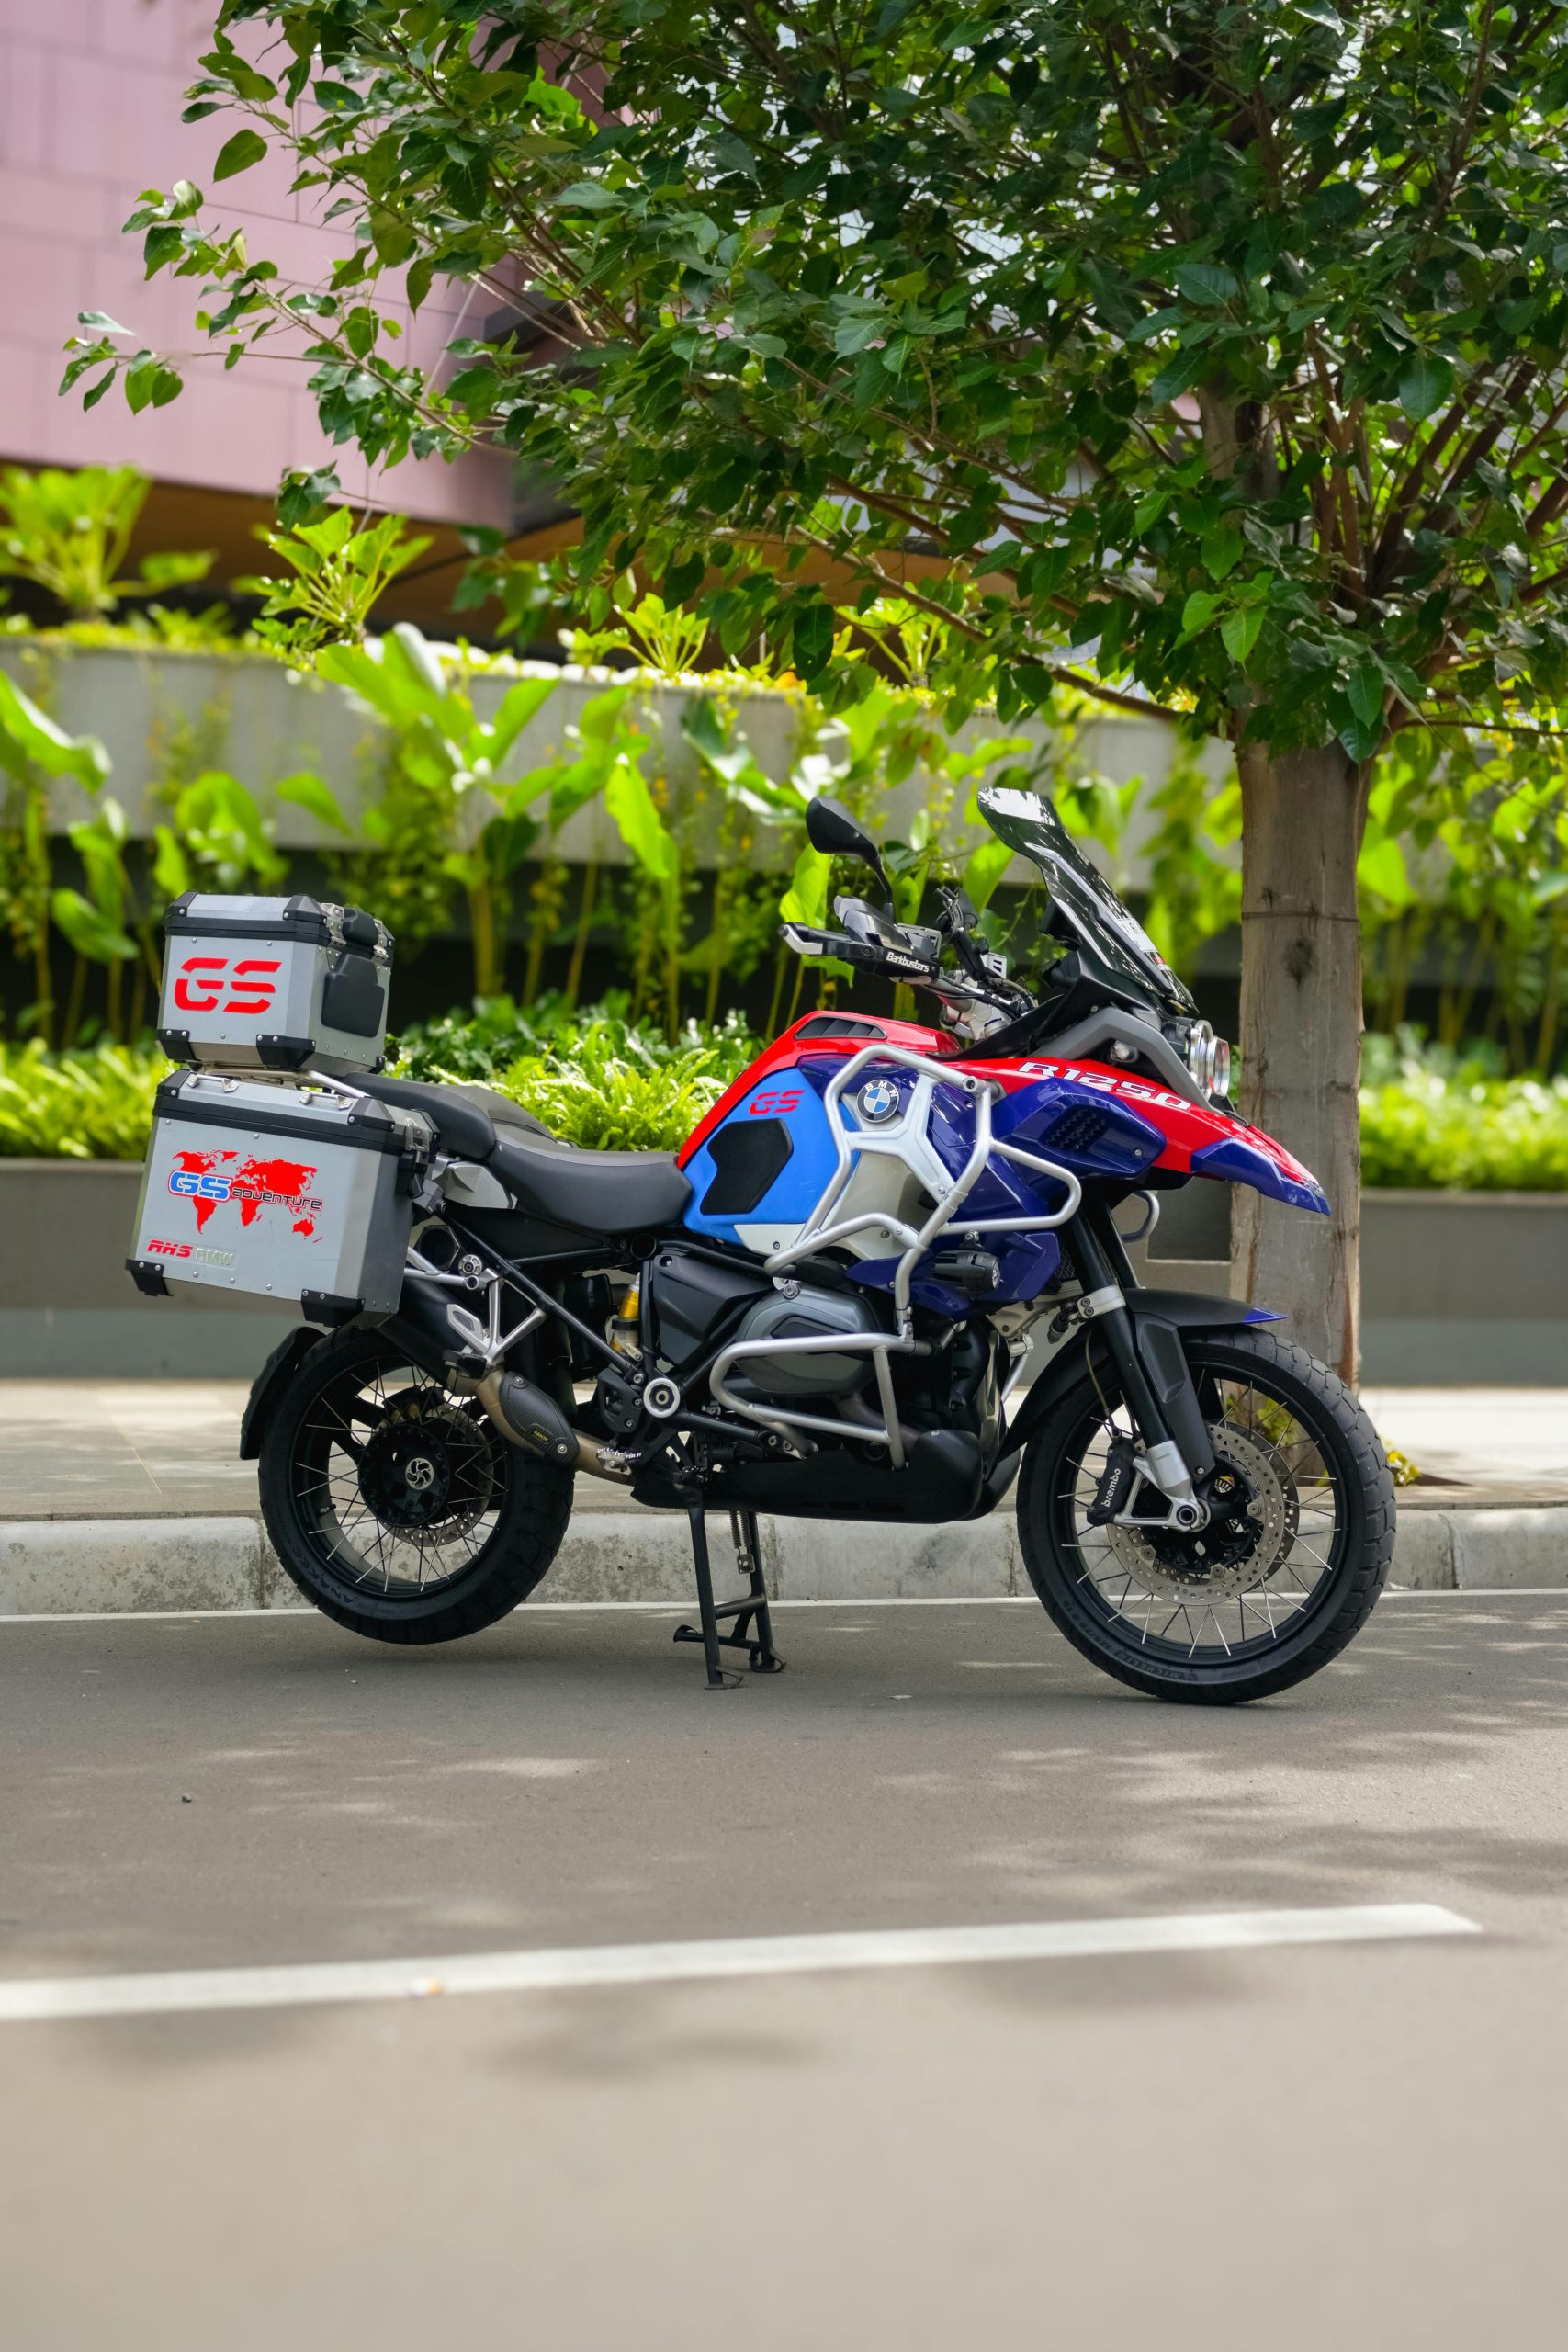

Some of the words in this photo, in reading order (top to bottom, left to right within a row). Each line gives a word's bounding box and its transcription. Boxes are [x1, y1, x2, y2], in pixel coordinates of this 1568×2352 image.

[886, 952, 930, 973] Barkbusters
[175, 957, 282, 1014] GS
[865, 1081, 897, 1098] BMW
[1018, 1061, 1191, 1110] R1250
[750, 1090, 805, 1114] GS
[170, 1170, 231, 1200] GS
[196, 1248, 234, 1265] BMW
[1100, 1468, 1121, 1508] brembo
[1115, 1649, 1181, 1680] MICHELIN
